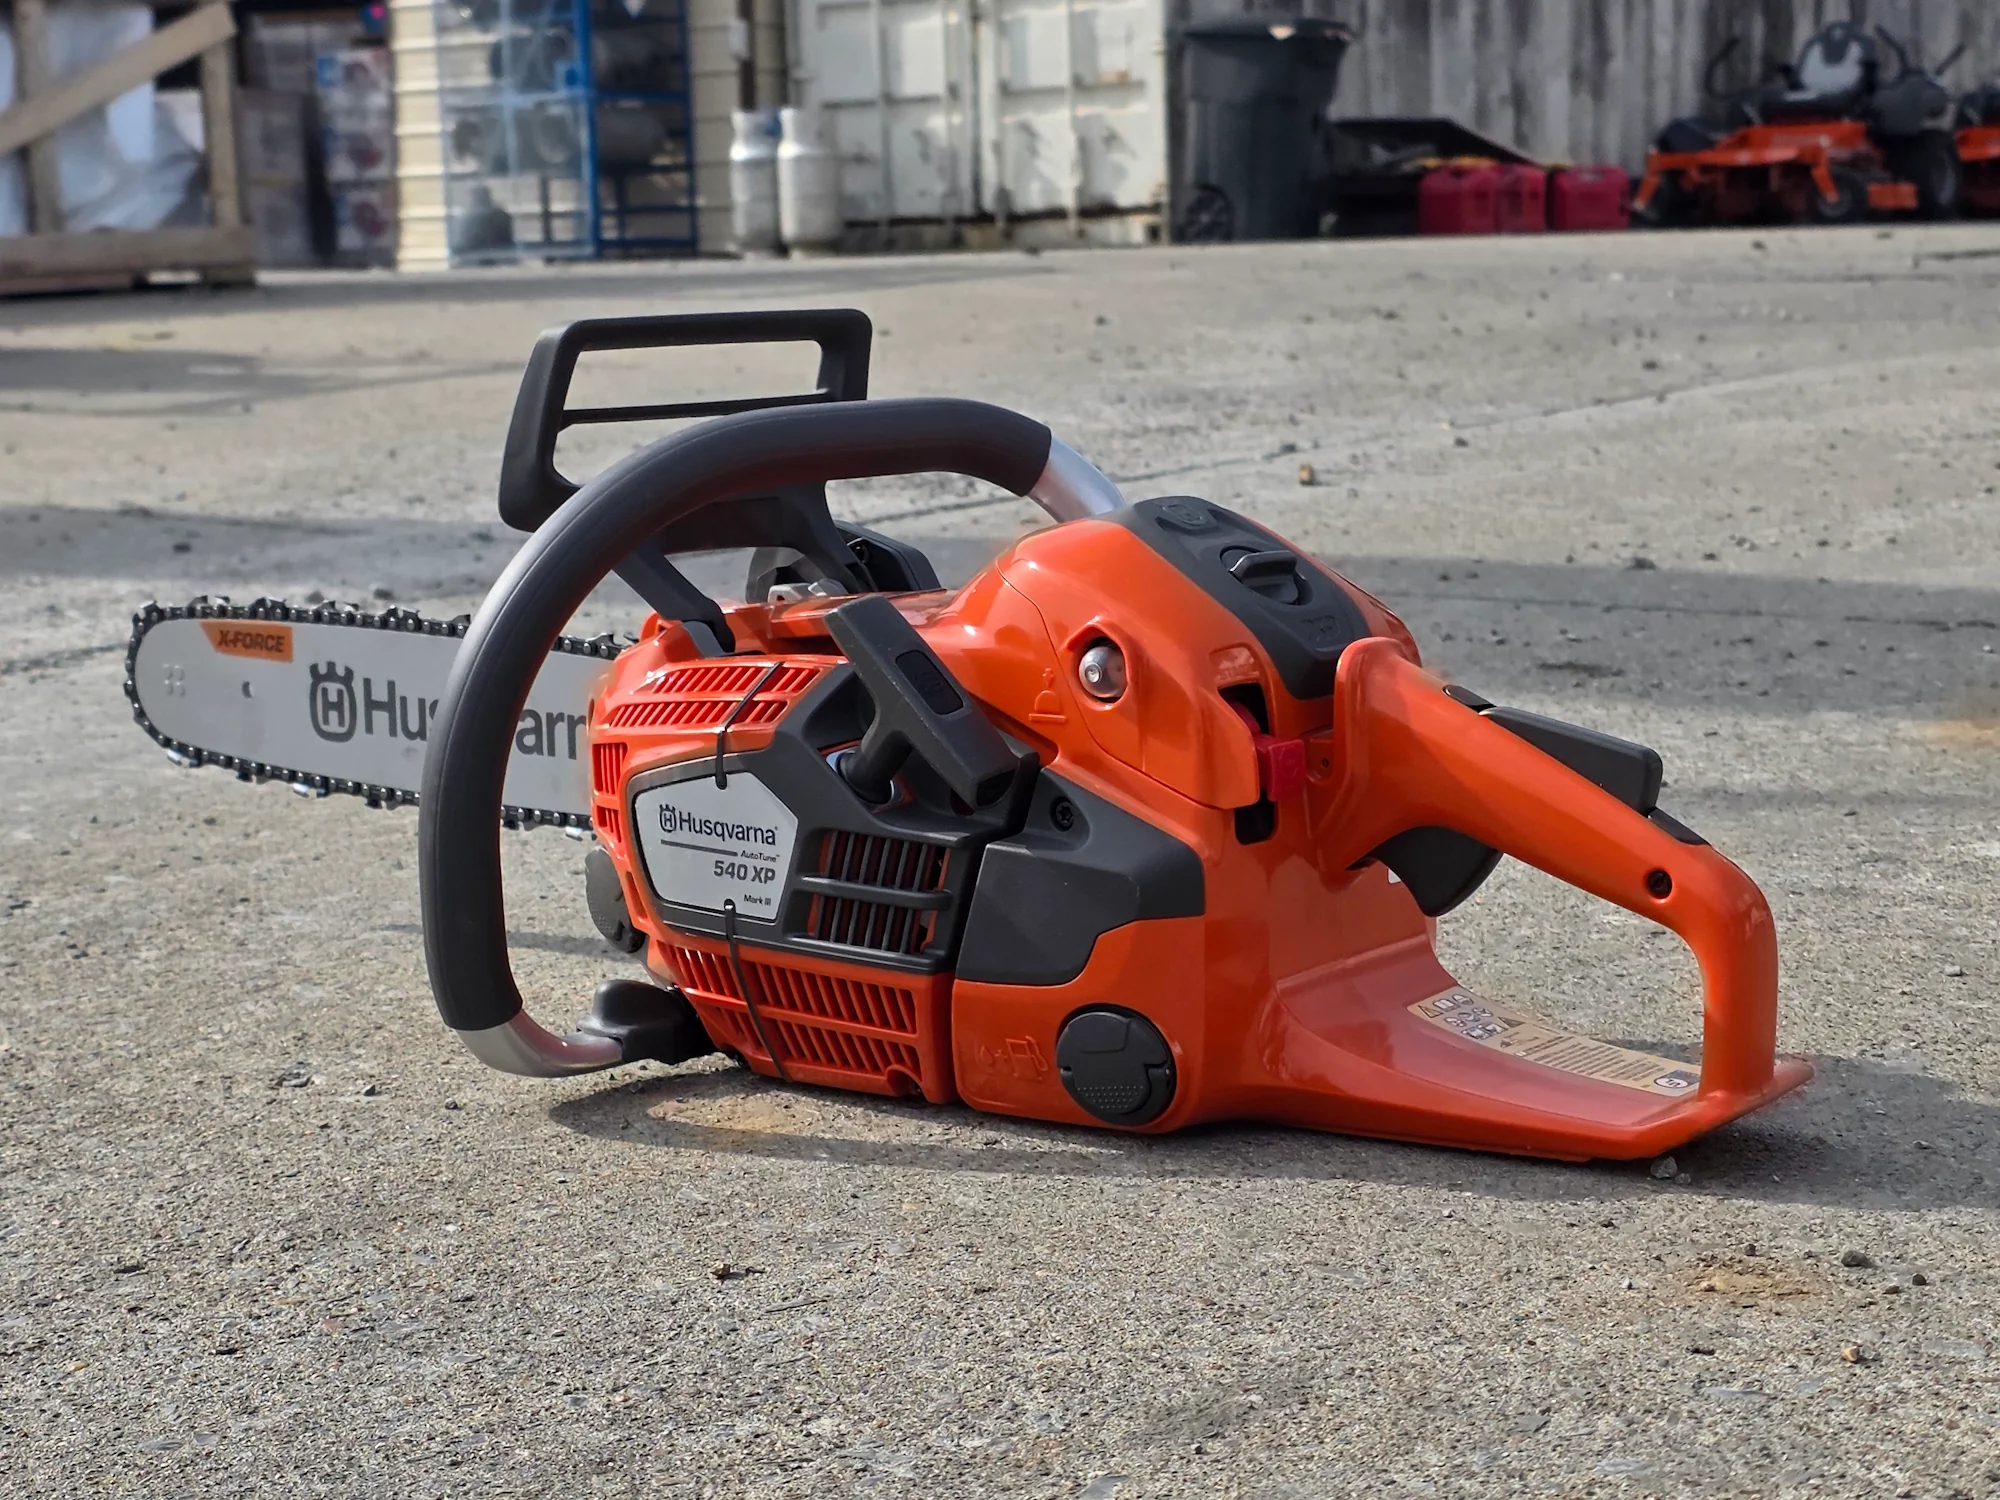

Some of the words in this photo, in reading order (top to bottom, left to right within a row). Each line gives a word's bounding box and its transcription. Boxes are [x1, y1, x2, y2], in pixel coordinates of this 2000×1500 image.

[218, 630, 285, 653] X-FORCE
[679, 810, 776, 846] Husqvarna
[741, 850, 777, 863] AutoTune
[713, 860, 748, 881] 540
[751, 865, 776, 885] XP
[743, 894, 763, 904] Mark
